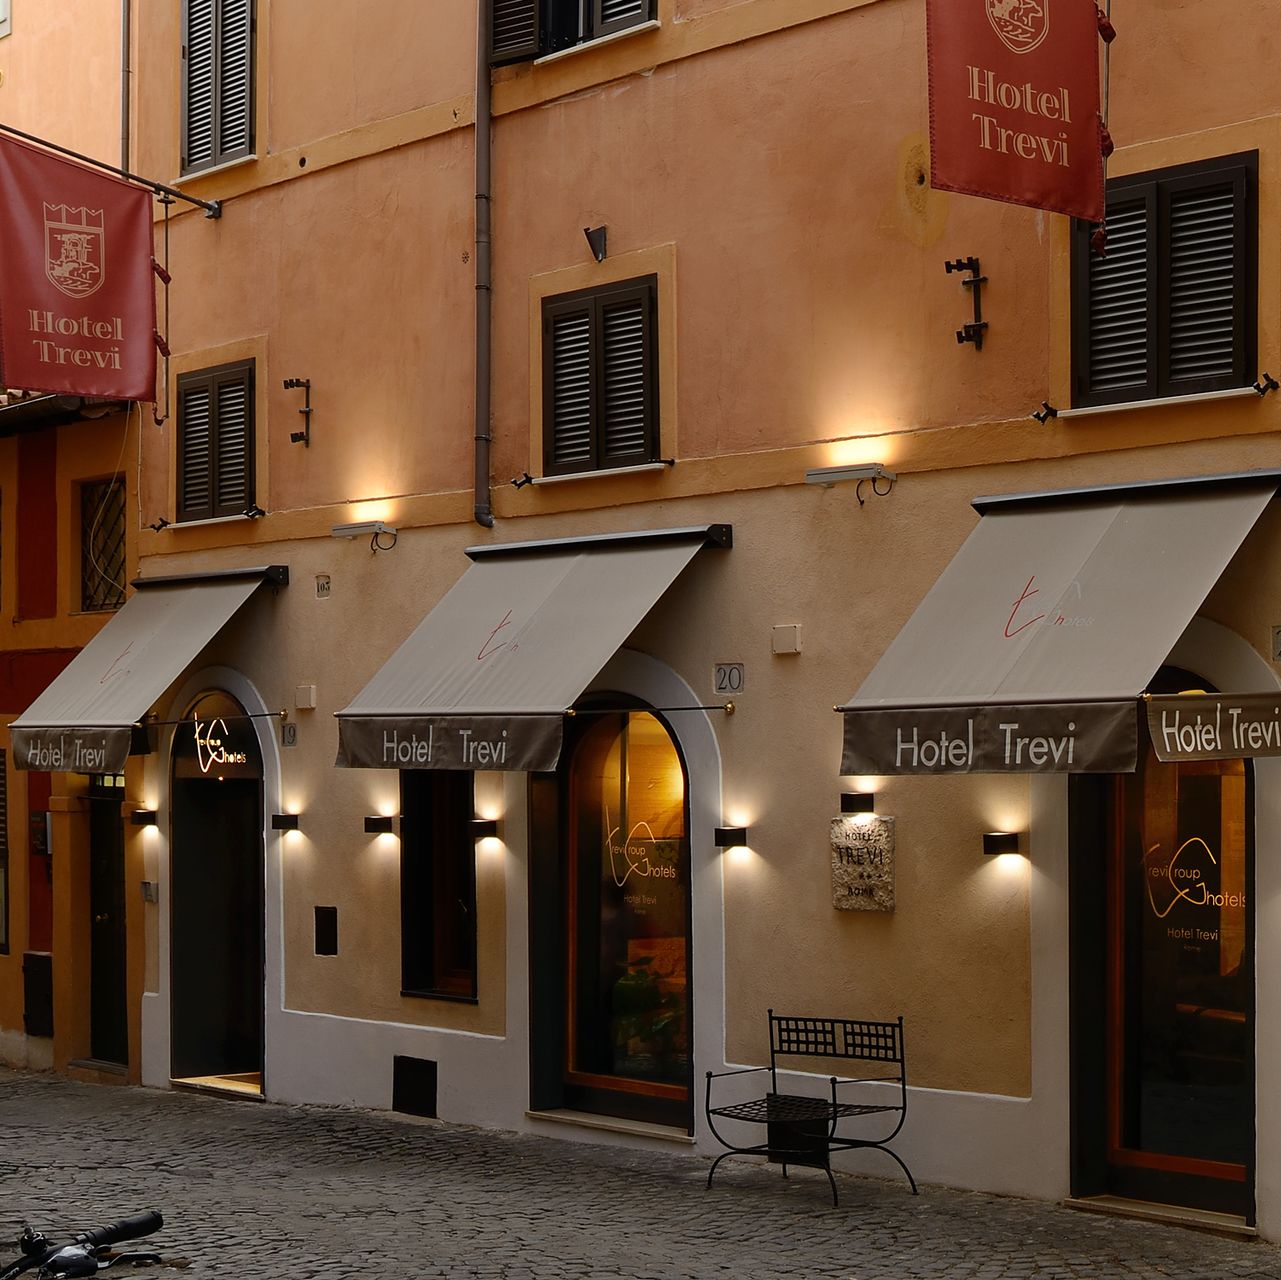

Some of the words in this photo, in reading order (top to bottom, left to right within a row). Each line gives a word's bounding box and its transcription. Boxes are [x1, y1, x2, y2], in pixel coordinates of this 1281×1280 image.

[965, 64, 1073, 124] Hotel
[971, 112, 1071, 168] Trevi
[27, 308, 125, 341] Hotel
[32, 339, 123, 370] Trevi
[716, 666, 742, 690] 20
[281, 724, 297, 745] 19
[895, 718, 974, 767] Hotel
[998, 721, 1076, 766] Trevi
[1161, 702, 1222, 753] Hotel
[1228, 706, 1281, 750] Trevi
[27, 735, 65, 766] Hotel
[74, 739, 107, 767] Trevi
[383, 724, 434, 763] Hotel
[458, 729, 508, 764] Trevi
[844, 831, 874, 842] HOTEL
[836, 846, 884, 865] TREVI
[647, 865, 677, 879] hotels
[1167, 927, 1194, 940] Hotel
[1195, 927, 1218, 941] Trevi
